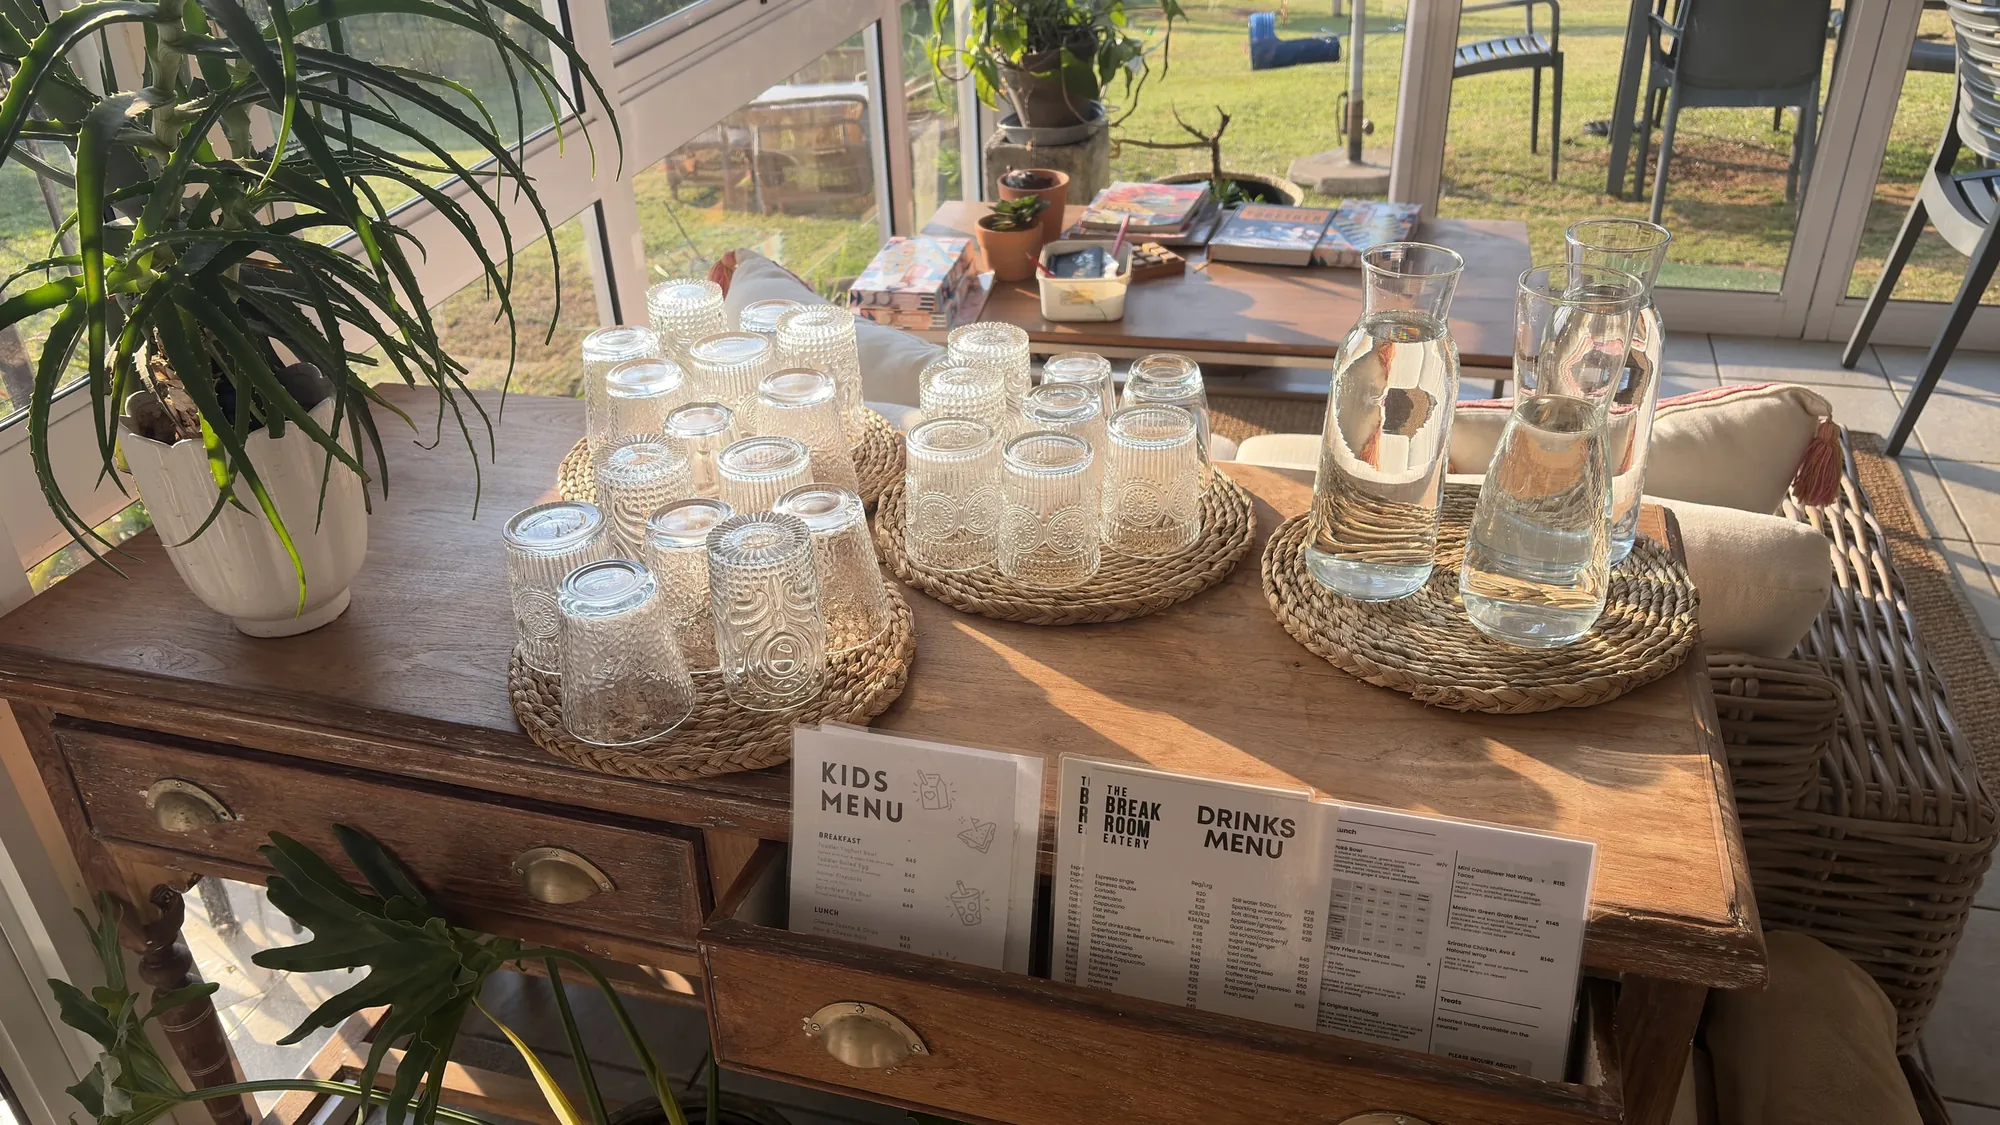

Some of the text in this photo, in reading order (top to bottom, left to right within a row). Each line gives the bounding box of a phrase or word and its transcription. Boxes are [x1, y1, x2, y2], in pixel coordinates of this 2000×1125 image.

[821, 761, 888, 792] KIDS
[1107, 785, 1127, 797] THE
[821, 789, 903, 823] MENU
[1105, 796, 1161, 821] BREAK
[1104, 814, 1150, 838] ROOM
[1197, 805, 1296, 838] DRINKS
[1337, 826, 1357, 835] Lunch
[818, 832, 861, 844] BREAKFAST
[1103, 833, 1149, 849] EATERY
[1203, 829, 1283, 859] MENU
[1471, 867, 1504, 876] Cauliflower
[1095, 873, 1118, 882] Espresso
[1095, 880, 1117, 888] Espresso
[1094, 886, 1116, 894] Cortado
[1094, 893, 1122, 902] Americano
[1093, 900, 1125, 909] Cappuccino
[1232, 904, 1257, 913] Sparkling
[1259, 901, 1276, 909] 500ml
[814, 906, 838, 916] LUNCH
[1264, 917, 1283, 925] variety
[1091, 926, 1118, 934] Superfood
[1152, 936, 1175, 945] Turmeric
[1107, 935, 1127, 943] Matcha
[1101, 941, 1133, 950] Cappuccino
[1447, 940, 1471, 948] Sriracha
[1472, 944, 1497, 953] Chicken,
[1090, 946, 1113, 954] Mesquite
[1114, 950, 1142, 959] Americano
[1446, 947, 1471, 955] Haloumi
[1089, 952, 1145, 966] Mesquite Cappuccino
[1088, 971, 1108, 979] Rooibos
[1249, 968, 1273, 976] espresso
[1266, 985, 1291, 993] espresso
[1440, 996, 1461, 1005] Treats
[1326, 1002, 1348, 1010] Original
[1437, 1016, 1462, 1025] Assorted
[1481, 1025, 1509, 1034] available
[1448, 1052, 1468, 1060] PLEASE
[1470, 1056, 1494, 1066] INQUIRE
